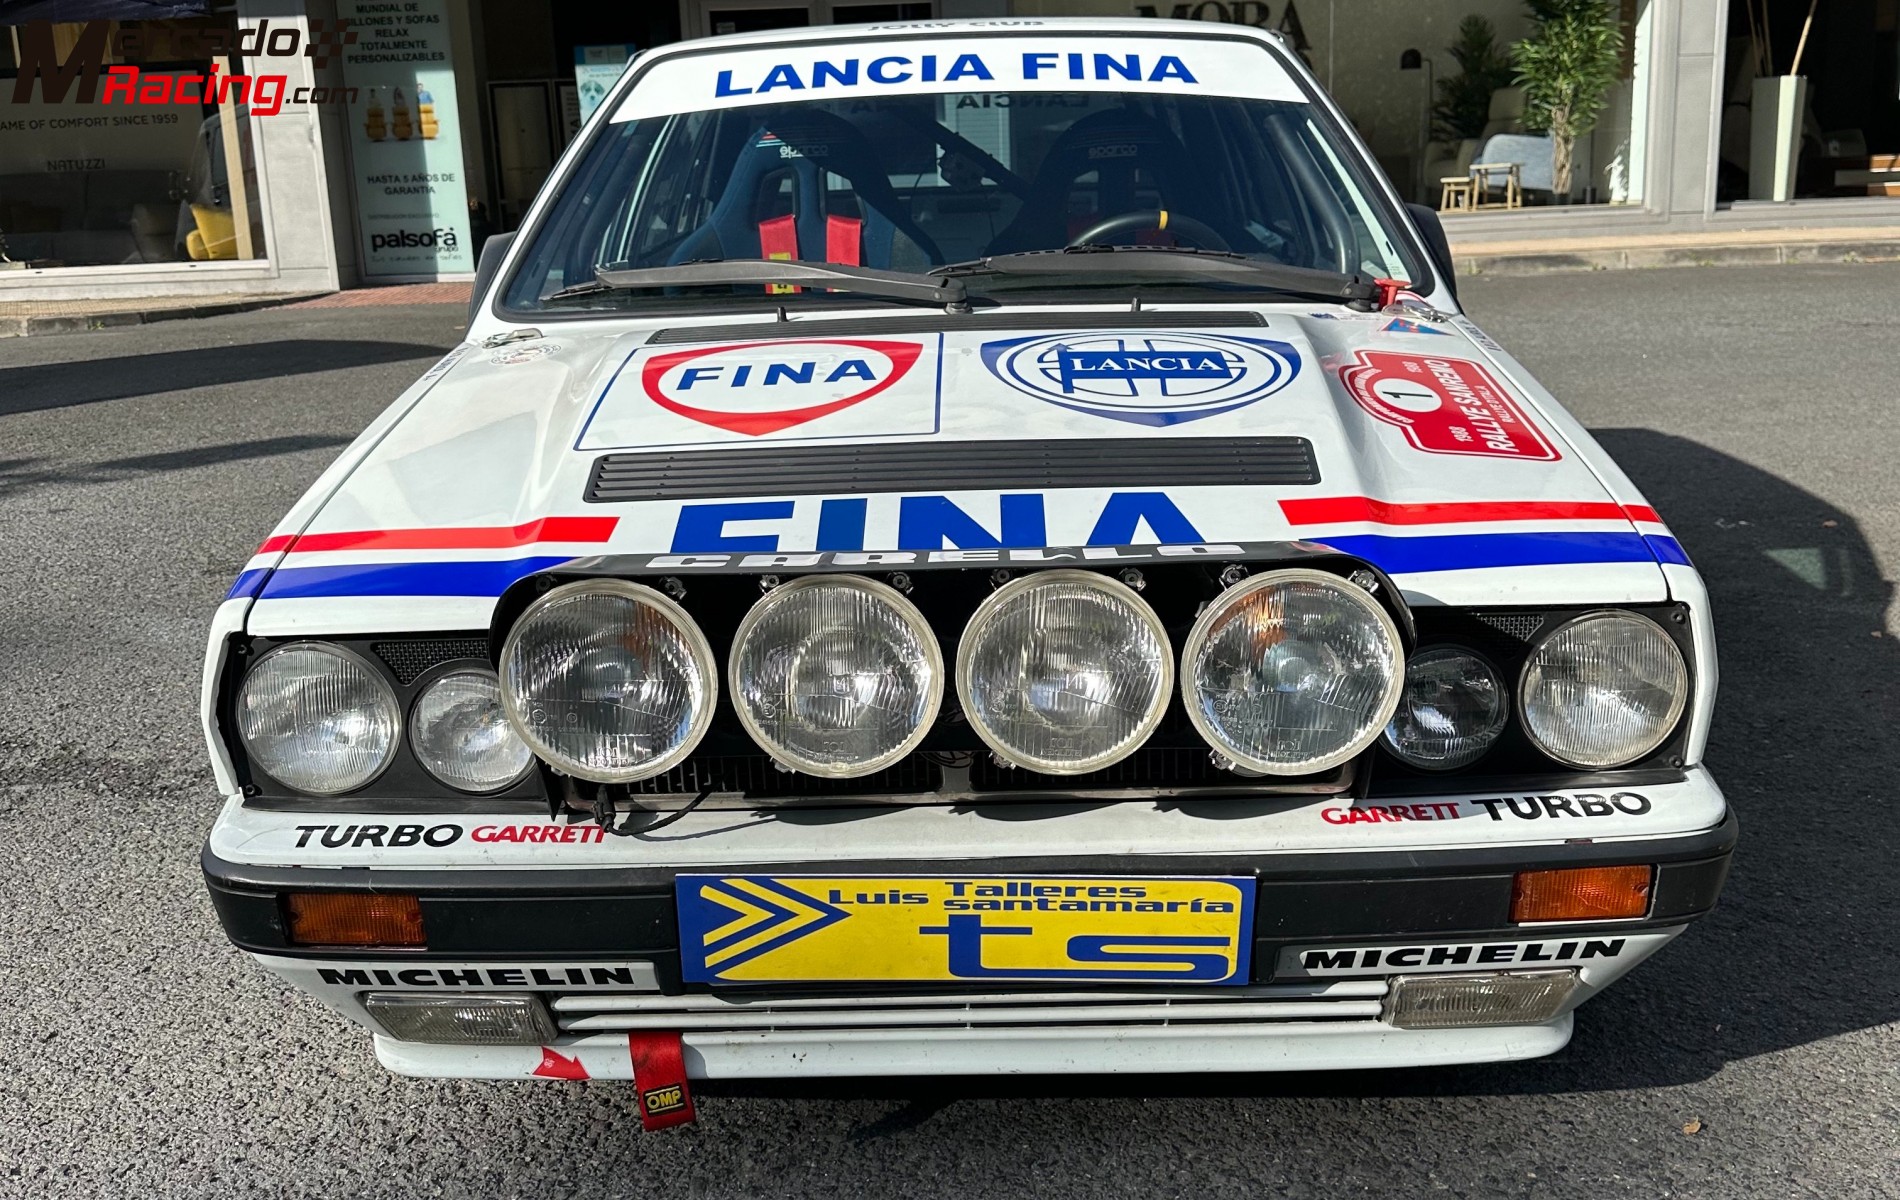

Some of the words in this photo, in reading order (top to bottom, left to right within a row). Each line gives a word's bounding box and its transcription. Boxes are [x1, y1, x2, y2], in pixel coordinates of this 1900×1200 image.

[356, 4, 401, 13] MUNDIAL
[404, 3, 418, 12] DE
[375, 28, 409, 37] RELAX
[868, 22, 955, 31] JOLLY
[360, 40, 428, 51] TOTALMENTE
[347, 52, 445, 64] PERSONALIZABLES
[716, 54, 995, 97] LANCIA
[1022, 53, 1199, 84] FINA
[29, 119, 46, 130] OF
[49, 116, 109, 129] COMFORT
[113, 115, 149, 126] SINCE
[152, 113, 178, 124] 1959
[47, 159, 106, 171] NATUZZI
[367, 174, 400, 184] HASTA
[403, 174, 410, 183] 5
[411, 172, 439, 183] AÑOS
[441, 173, 455, 182] DE
[677, 359, 876, 390] FINA
[1069, 358, 1224, 371] LANCIA
[1423, 359, 1484, 406] SANREMO
[1459, 405, 1520, 452] RALLYE
[670, 491, 1206, 553] FINA
[1321, 802, 1459, 825] GARRETT
[1470, 791, 1652, 822] TURBO
[296, 824, 463, 848] TURBO
[471, 825, 605, 843] GARRETT
[944, 880, 1146, 897] Talleres
[829, 889, 929, 905] Luis
[943, 896, 1234, 914] santamaría
[919, 913, 1231, 981] ts
[1302, 938, 1627, 969] MICHELIN
[317, 967, 635, 987] MICHELIN
[647, 1089, 681, 1109] OMP
